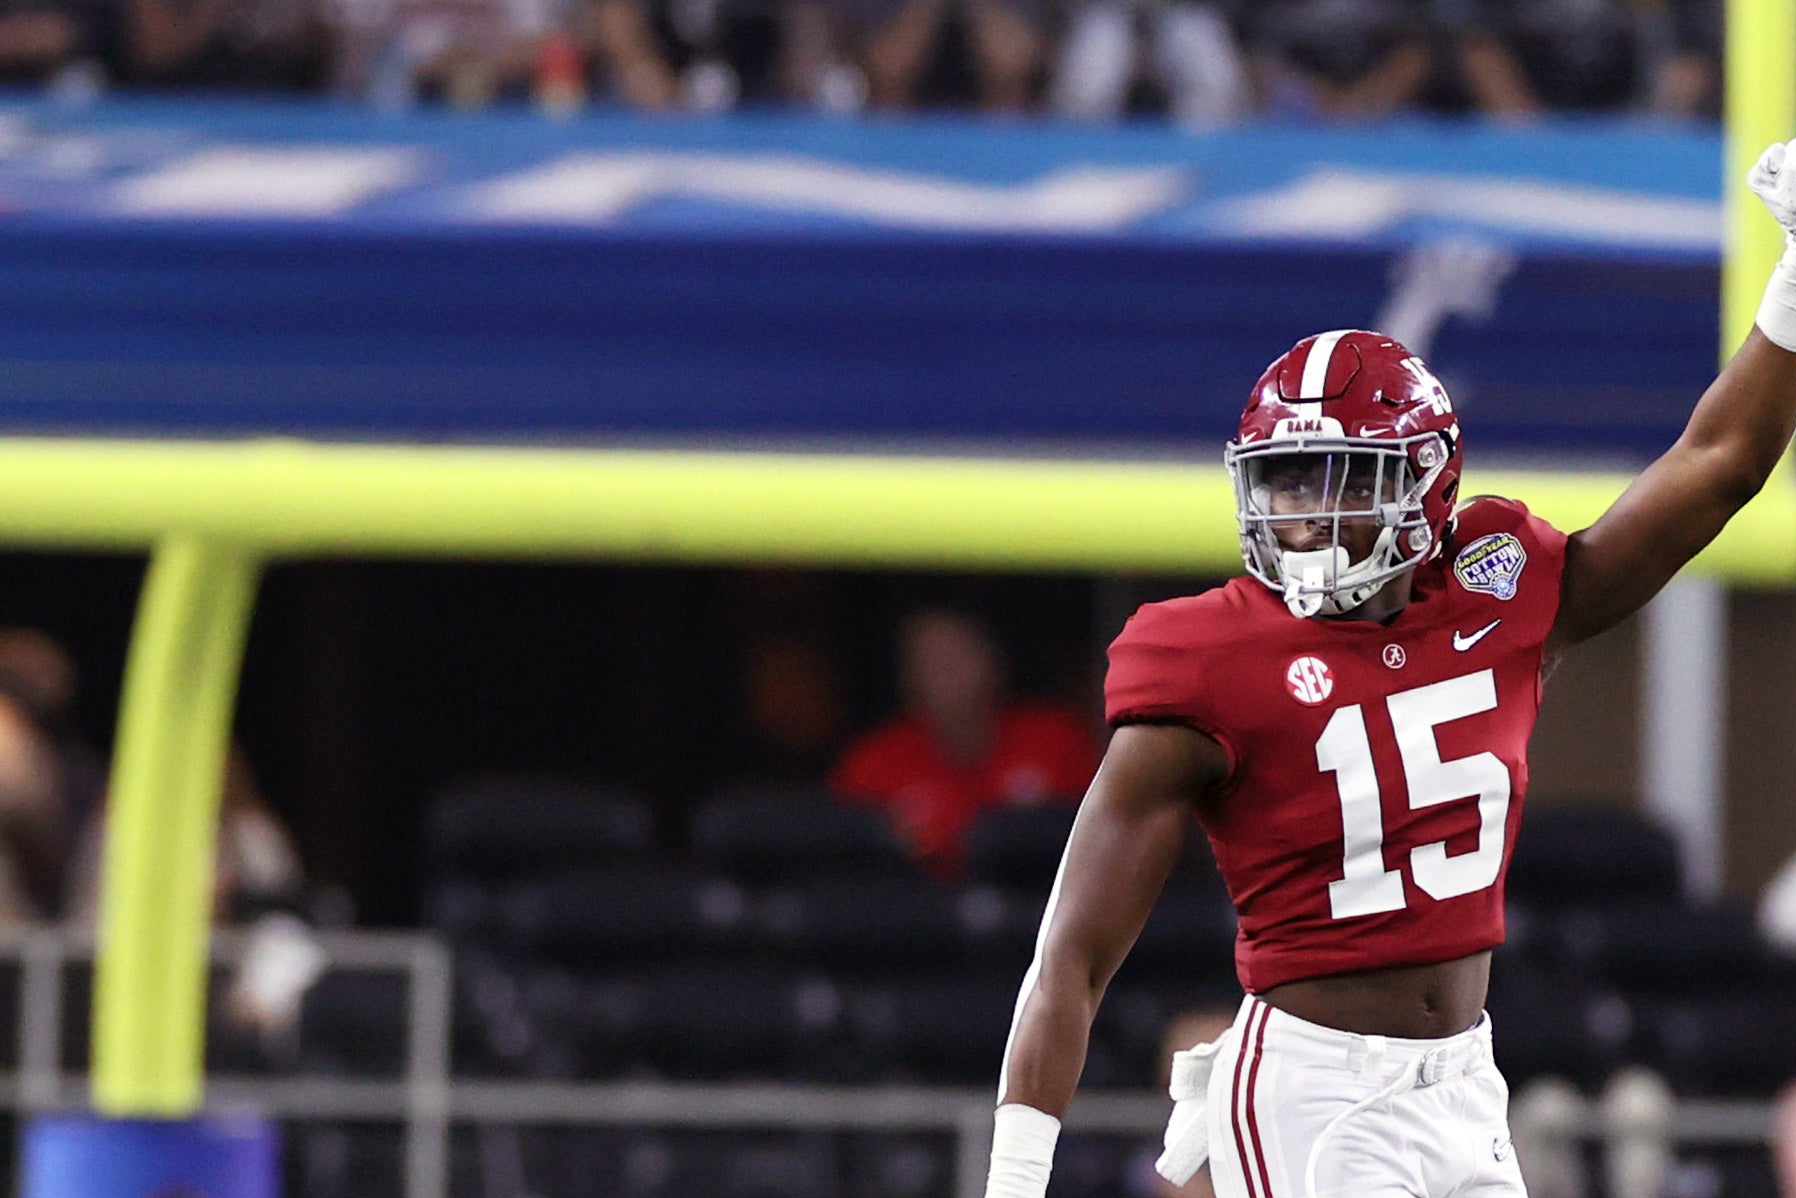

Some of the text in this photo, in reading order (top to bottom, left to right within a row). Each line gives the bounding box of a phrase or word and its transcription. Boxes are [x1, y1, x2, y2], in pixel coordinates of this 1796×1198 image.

[1287, 419, 1323, 433] BAMA
[1461, 542, 1520, 584] COTTON
[1477, 558, 1515, 584] BOWL
[1286, 656, 1334, 704] SEC
[1315, 667, 1511, 920] 15
